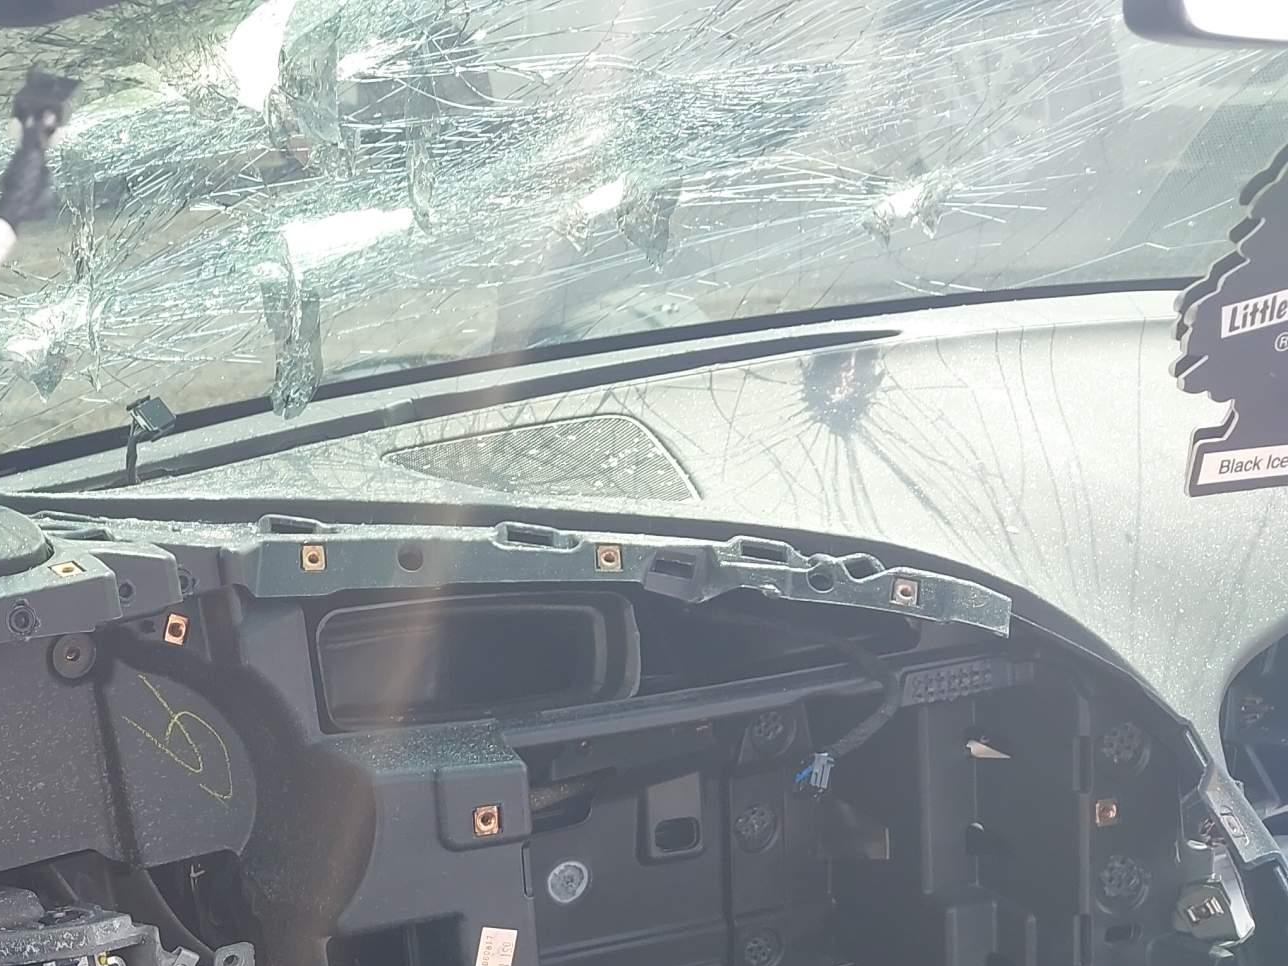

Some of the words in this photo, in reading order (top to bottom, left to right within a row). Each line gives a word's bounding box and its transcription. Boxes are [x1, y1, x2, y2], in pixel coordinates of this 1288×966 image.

[1228, 295, 1288, 333] Little
[1218, 455, 1261, 474] Black
[1265, 453, 1288, 469] Ice
